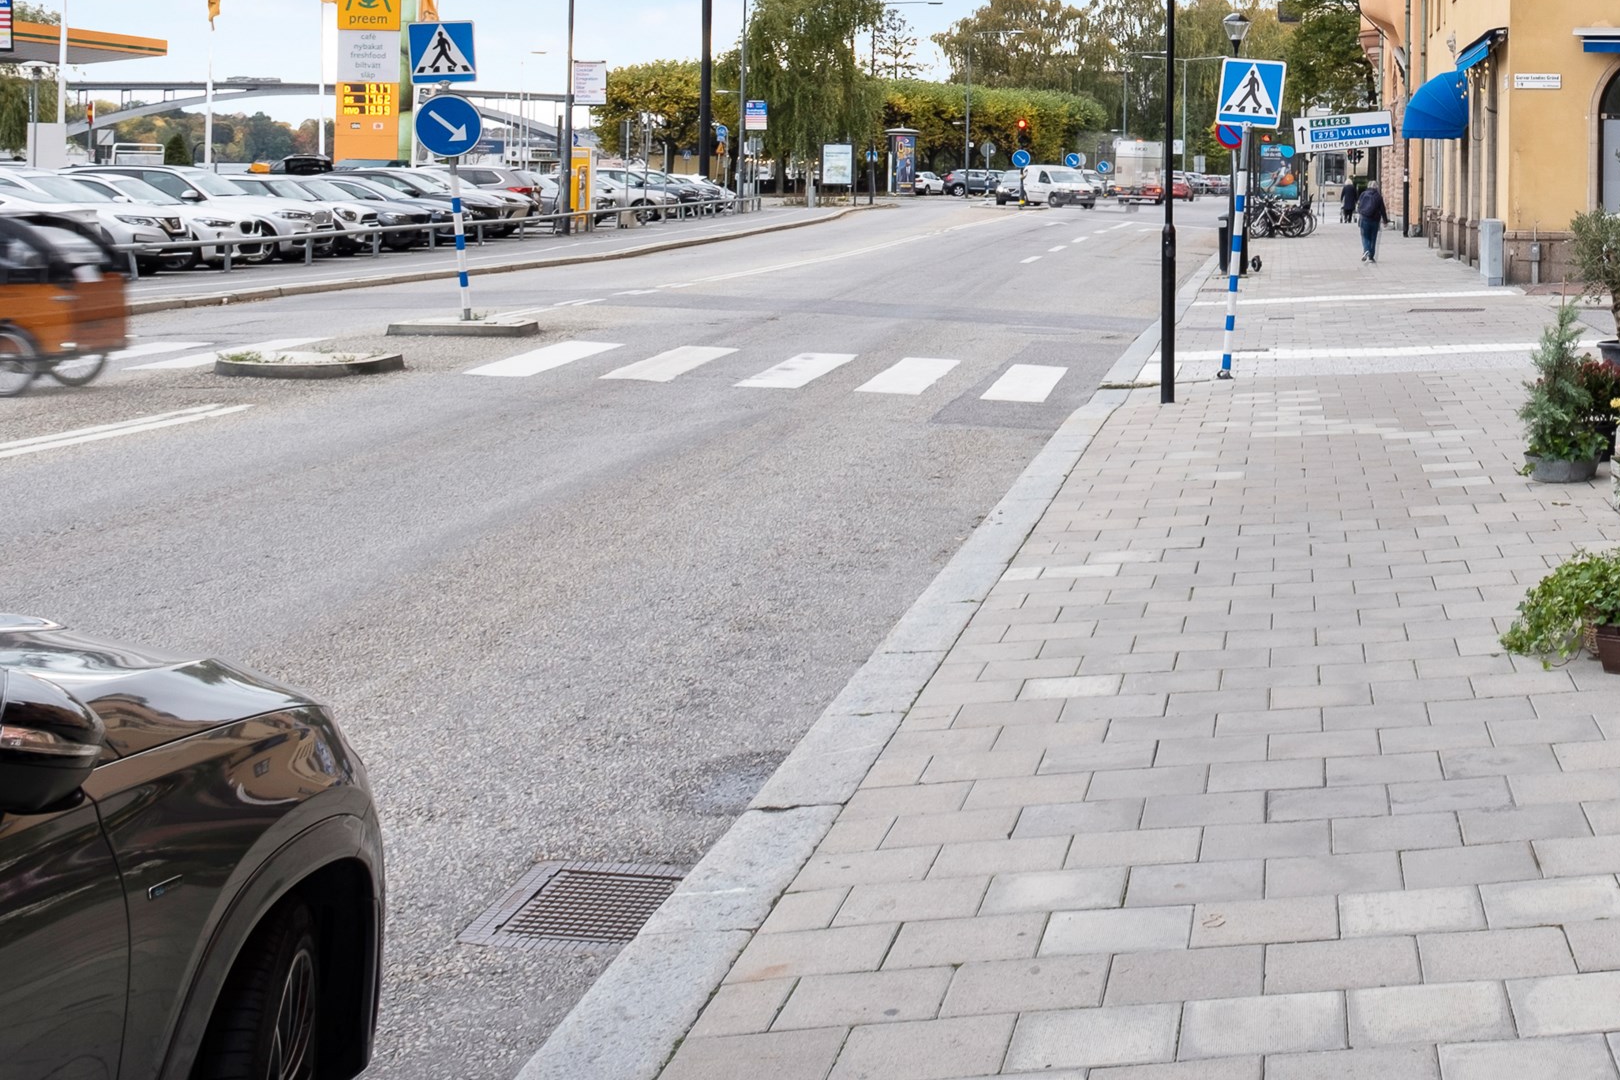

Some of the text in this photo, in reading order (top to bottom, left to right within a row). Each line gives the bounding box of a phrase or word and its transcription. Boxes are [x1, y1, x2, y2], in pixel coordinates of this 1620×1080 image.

[349, 14, 388, 25] preem
[353, 43, 383, 51] nybakat
[350, 51, 387, 59] freshfood
[354, 61, 381, 69] biltvätt
[360, 71, 376, 79] släp
[343, 85, 351, 94] D
[343, 96, 355, 104] 95
[343, 106, 360, 115] HVO
[1329, 118, 1347, 126] E20
[1318, 126, 1388, 139] 275 VÄLLINGBY
[1310, 139, 1370, 150] FRIDHEMSPLAN
